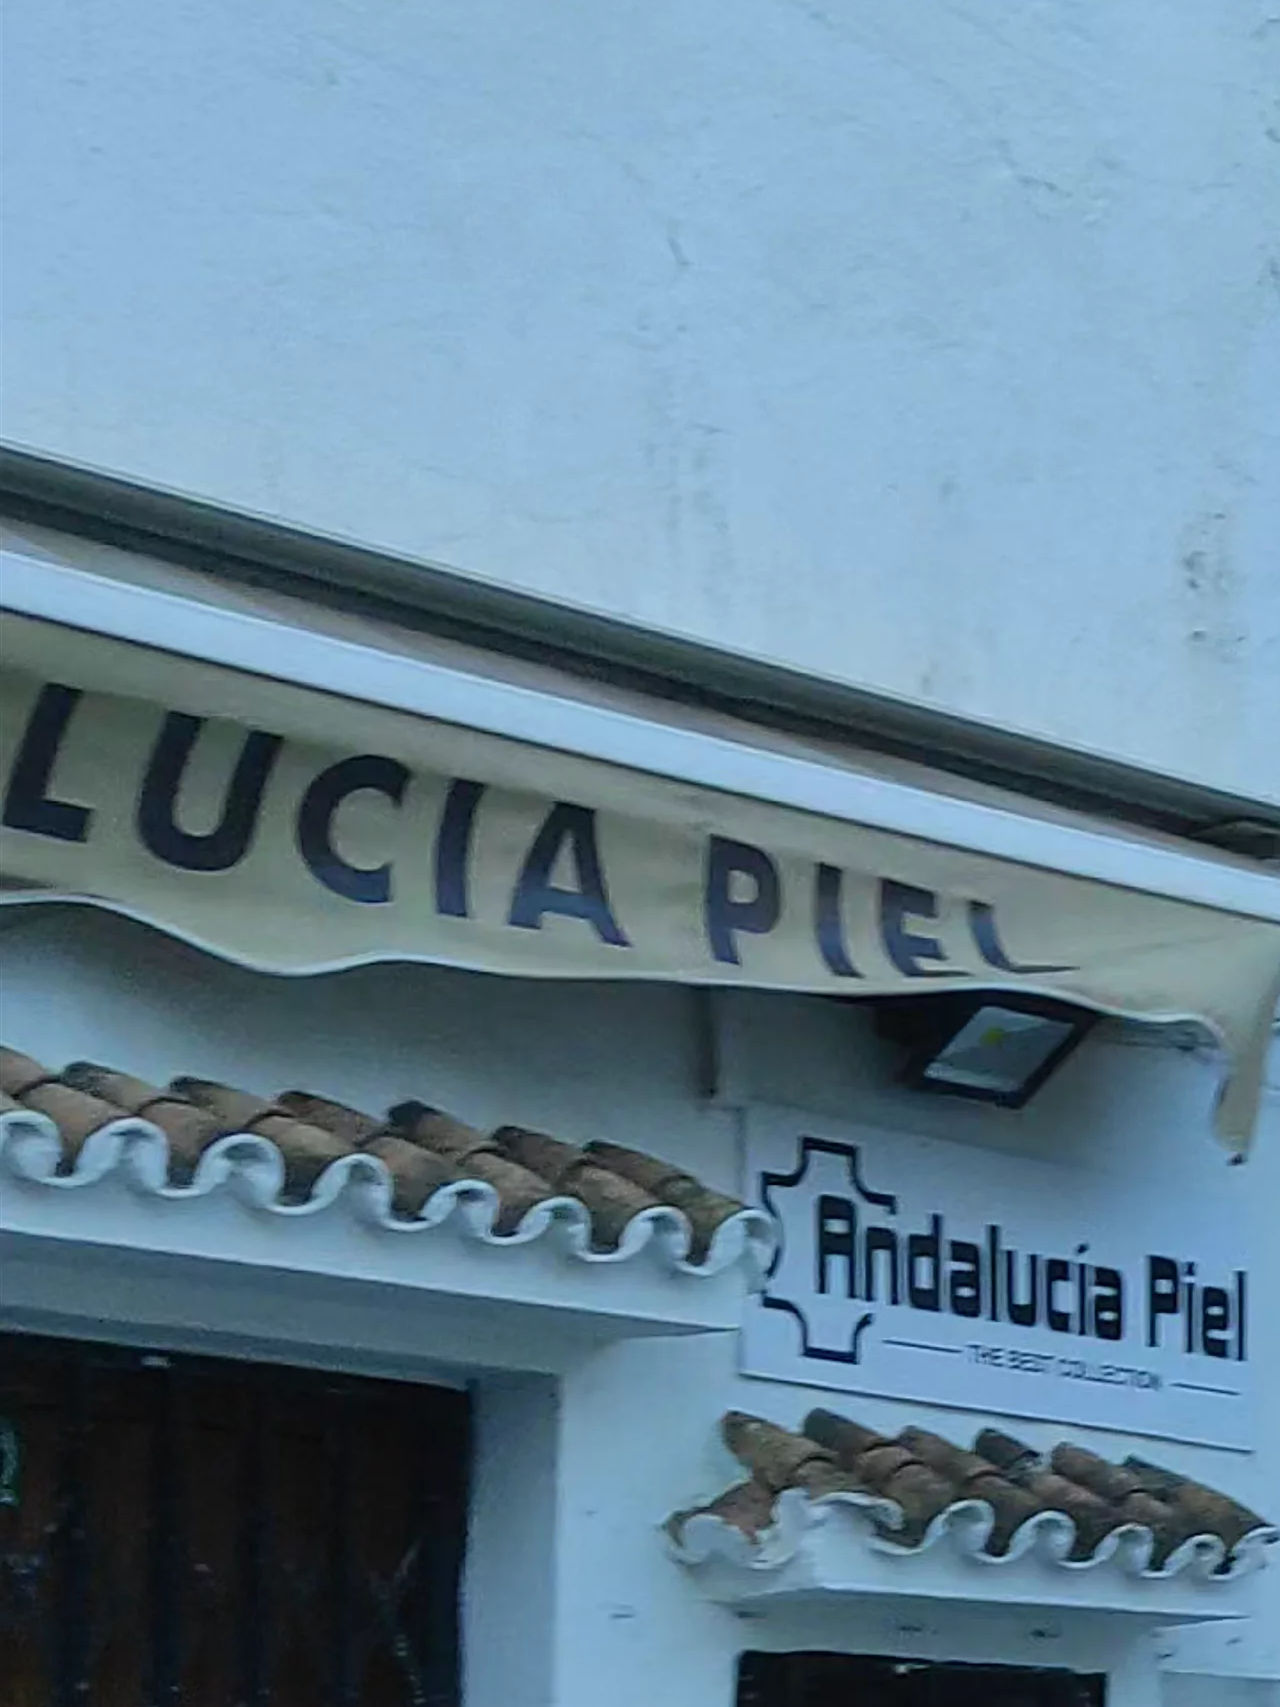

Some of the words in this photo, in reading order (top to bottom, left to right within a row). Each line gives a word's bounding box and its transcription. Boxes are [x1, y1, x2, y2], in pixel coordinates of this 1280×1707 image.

[705, 833, 1081, 978] PIEL
[818, 1194, 1123, 1342] Andalucía
[1145, 1254, 1249, 1362] Piel
[965, 1344, 1003, 1369] THE
[1007, 1350, 1055, 1373] BEST
[1058, 1358, 1162, 1390] COLLECTION
